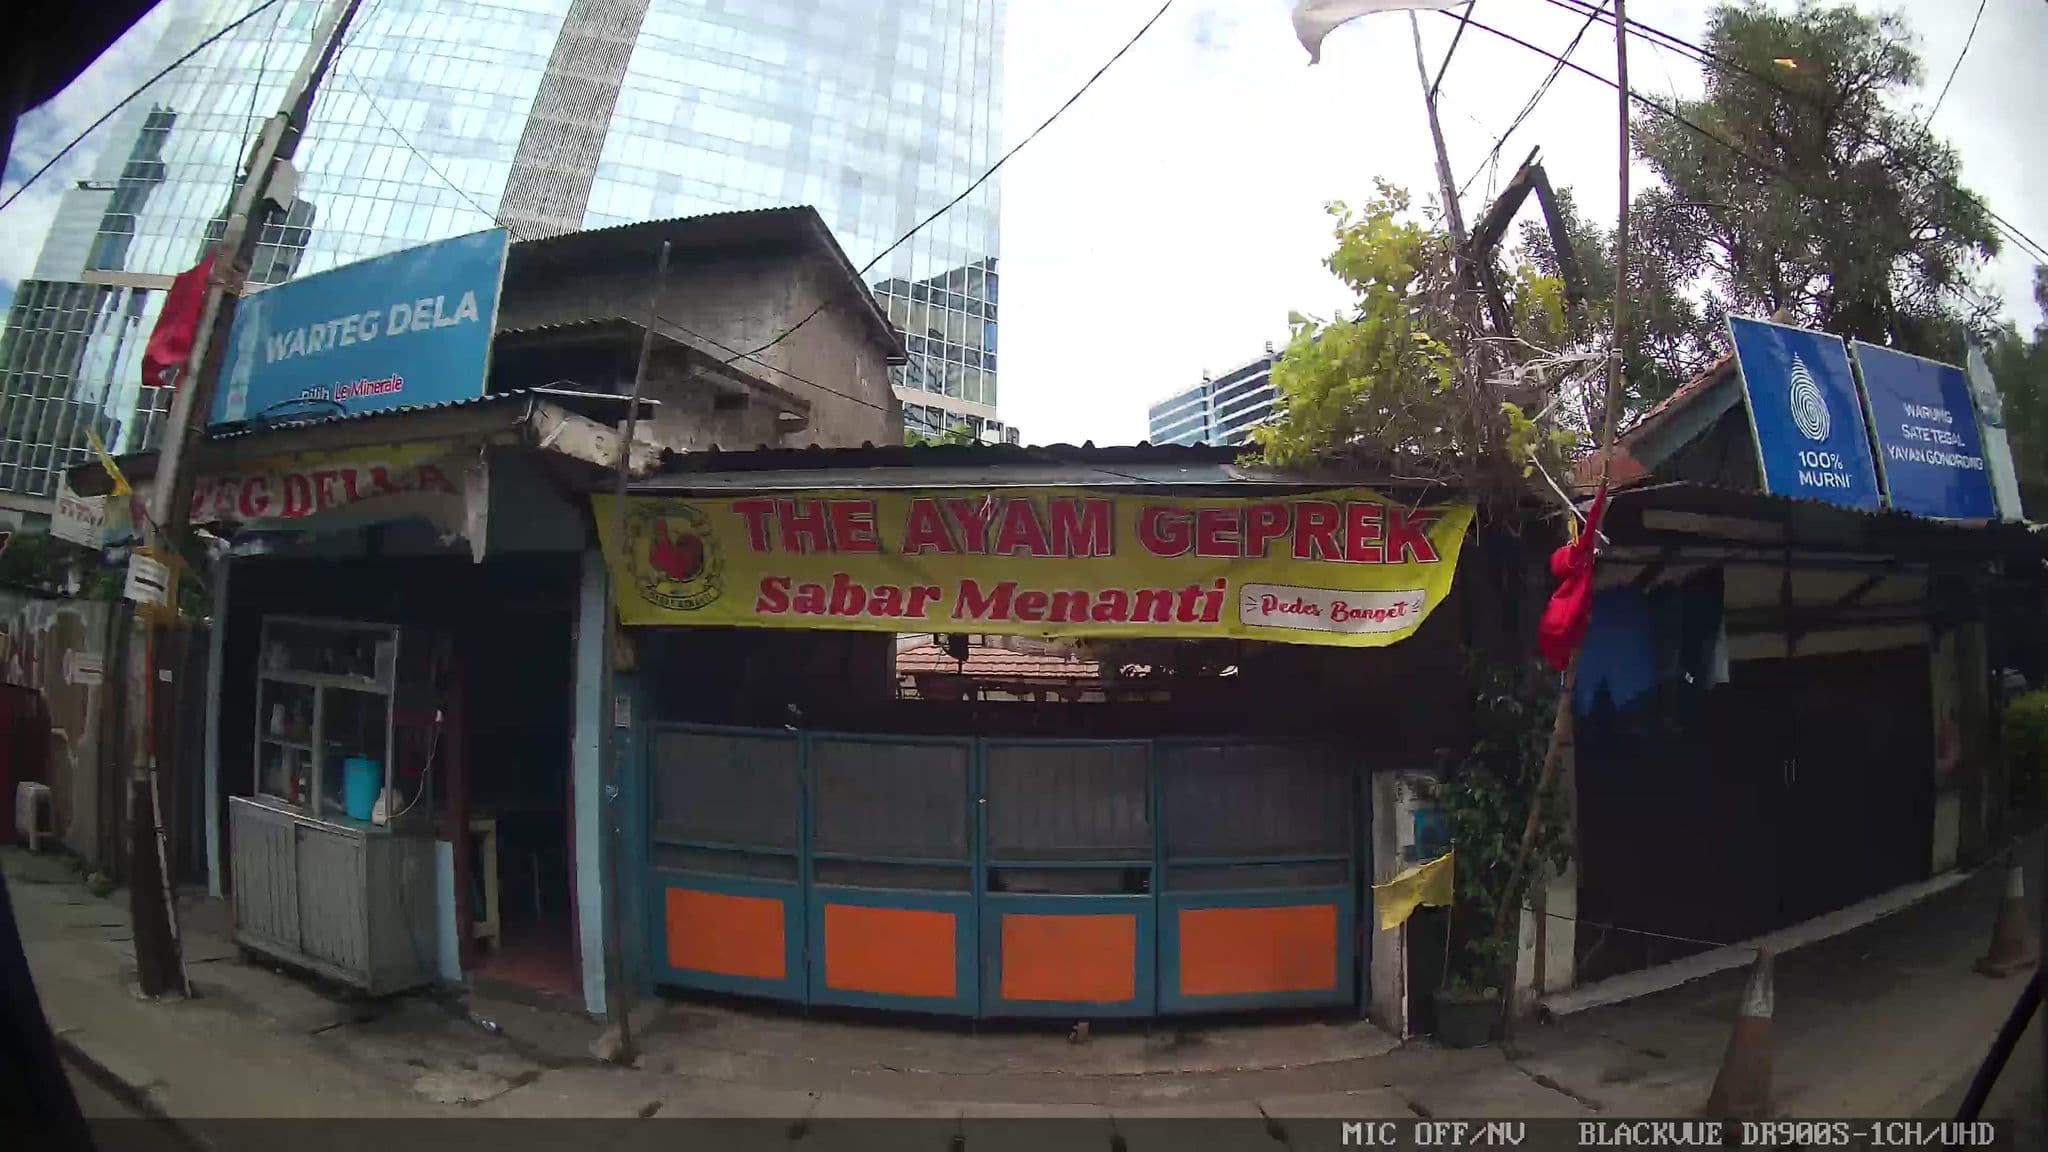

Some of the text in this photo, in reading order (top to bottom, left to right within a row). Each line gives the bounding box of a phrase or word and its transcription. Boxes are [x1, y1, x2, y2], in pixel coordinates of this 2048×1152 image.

[266, 290, 479, 363] WARTEG DELA
[334, 381, 349, 401] Le
[351, 372, 404, 397] Minerale
[1903, 402, 1953, 424] WARUNG
[1901, 424, 1966, 447] SATE TEGAL
[1799, 450, 1844, 470] 100%
[1886, 445, 1985, 471] YAYAN GONDRONG
[1799, 470, 1850, 488] MURNI
[732, 498, 1443, 564] THE AYAM GEPREK
[755, 572, 942, 619] Sabar
[951, 577, 1229, 624] Menanti
[1330, 601, 1410, 623] Banget
